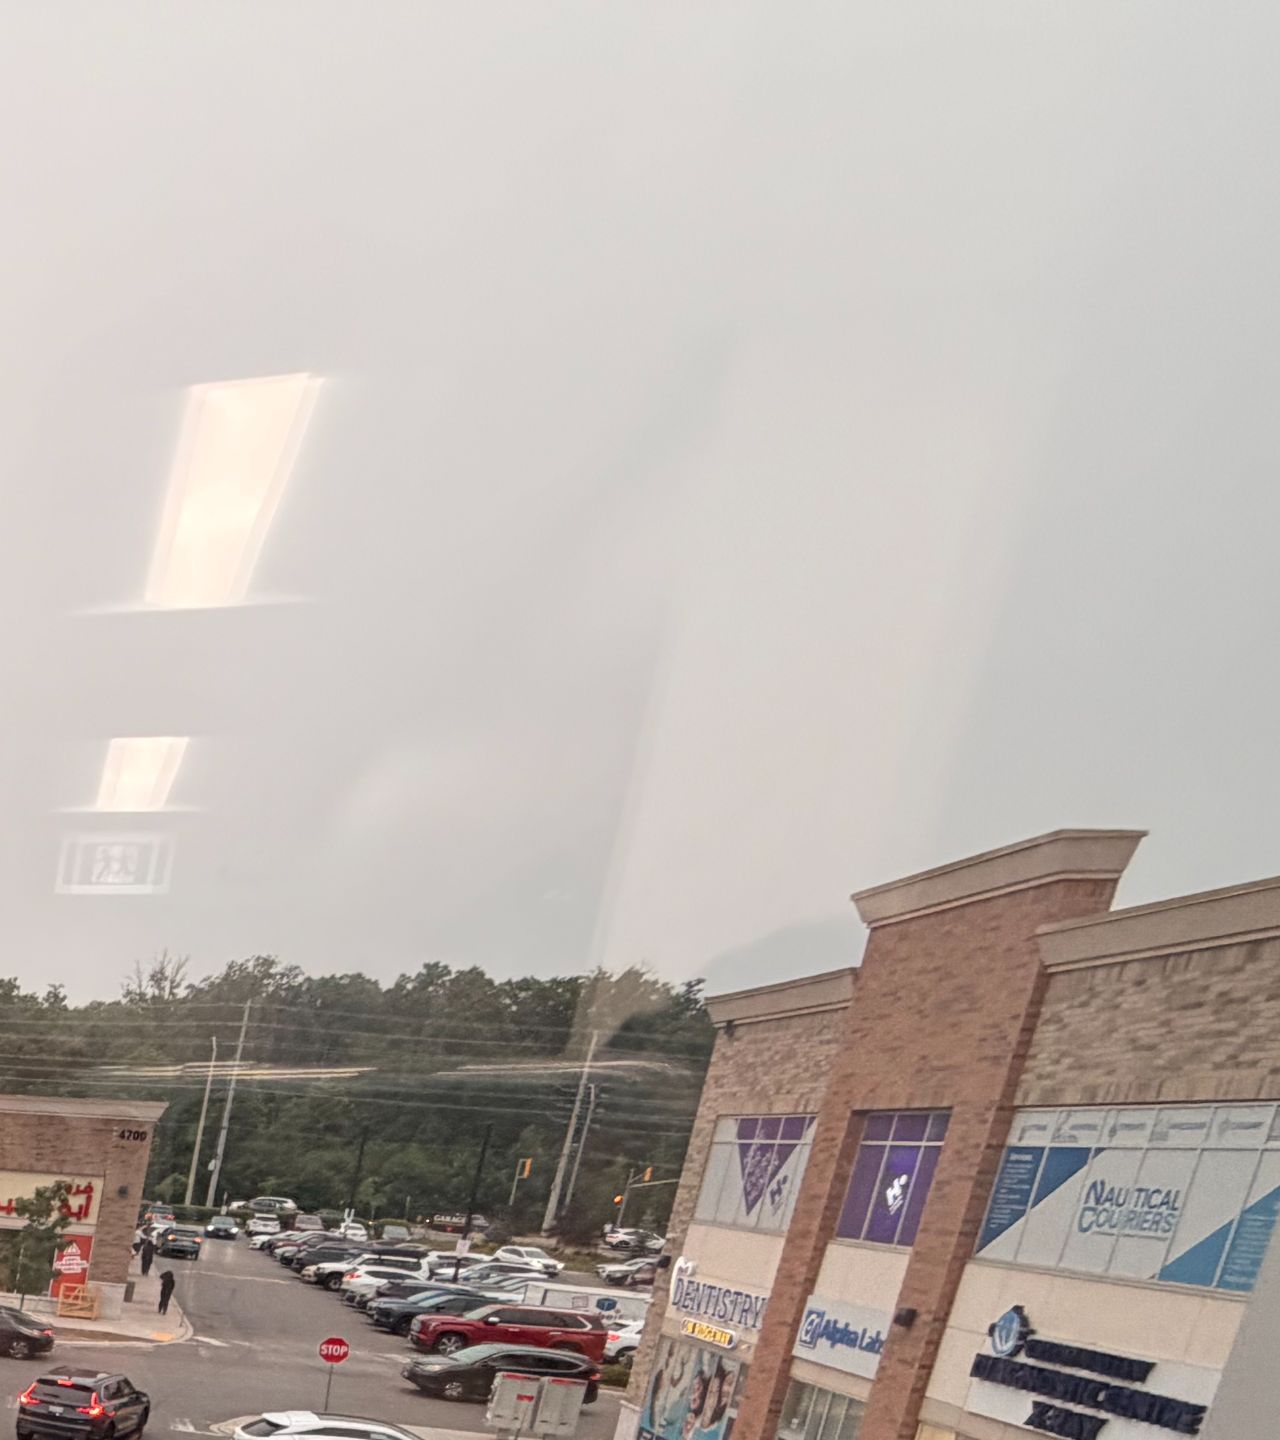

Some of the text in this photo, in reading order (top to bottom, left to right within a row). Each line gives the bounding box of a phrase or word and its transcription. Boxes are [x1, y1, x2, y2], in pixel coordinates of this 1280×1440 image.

[1083, 1178, 1181, 1212] NAUTICAL
[1077, 1206, 1179, 1234] COURIERS
[671, 1278, 768, 1329] DENTISTRY
[320, 1343, 348, 1357] STOP
